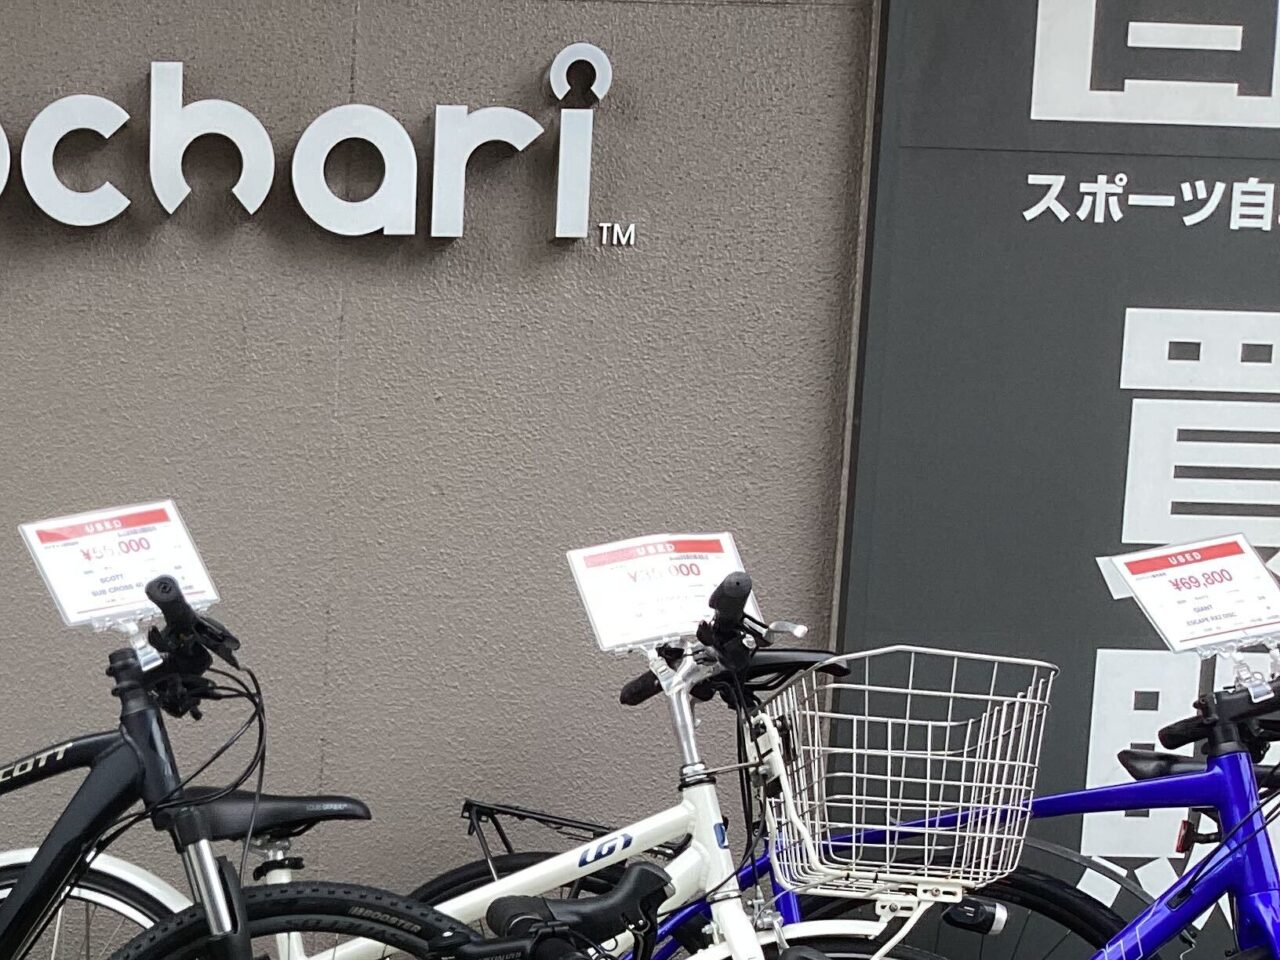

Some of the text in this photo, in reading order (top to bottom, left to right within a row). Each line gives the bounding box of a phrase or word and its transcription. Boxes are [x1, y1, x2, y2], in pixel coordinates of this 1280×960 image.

[598, 222, 636, 246] TM
[1167, 551, 1202, 565] USED
[1168, 568, 1233, 592] ¥69,800
